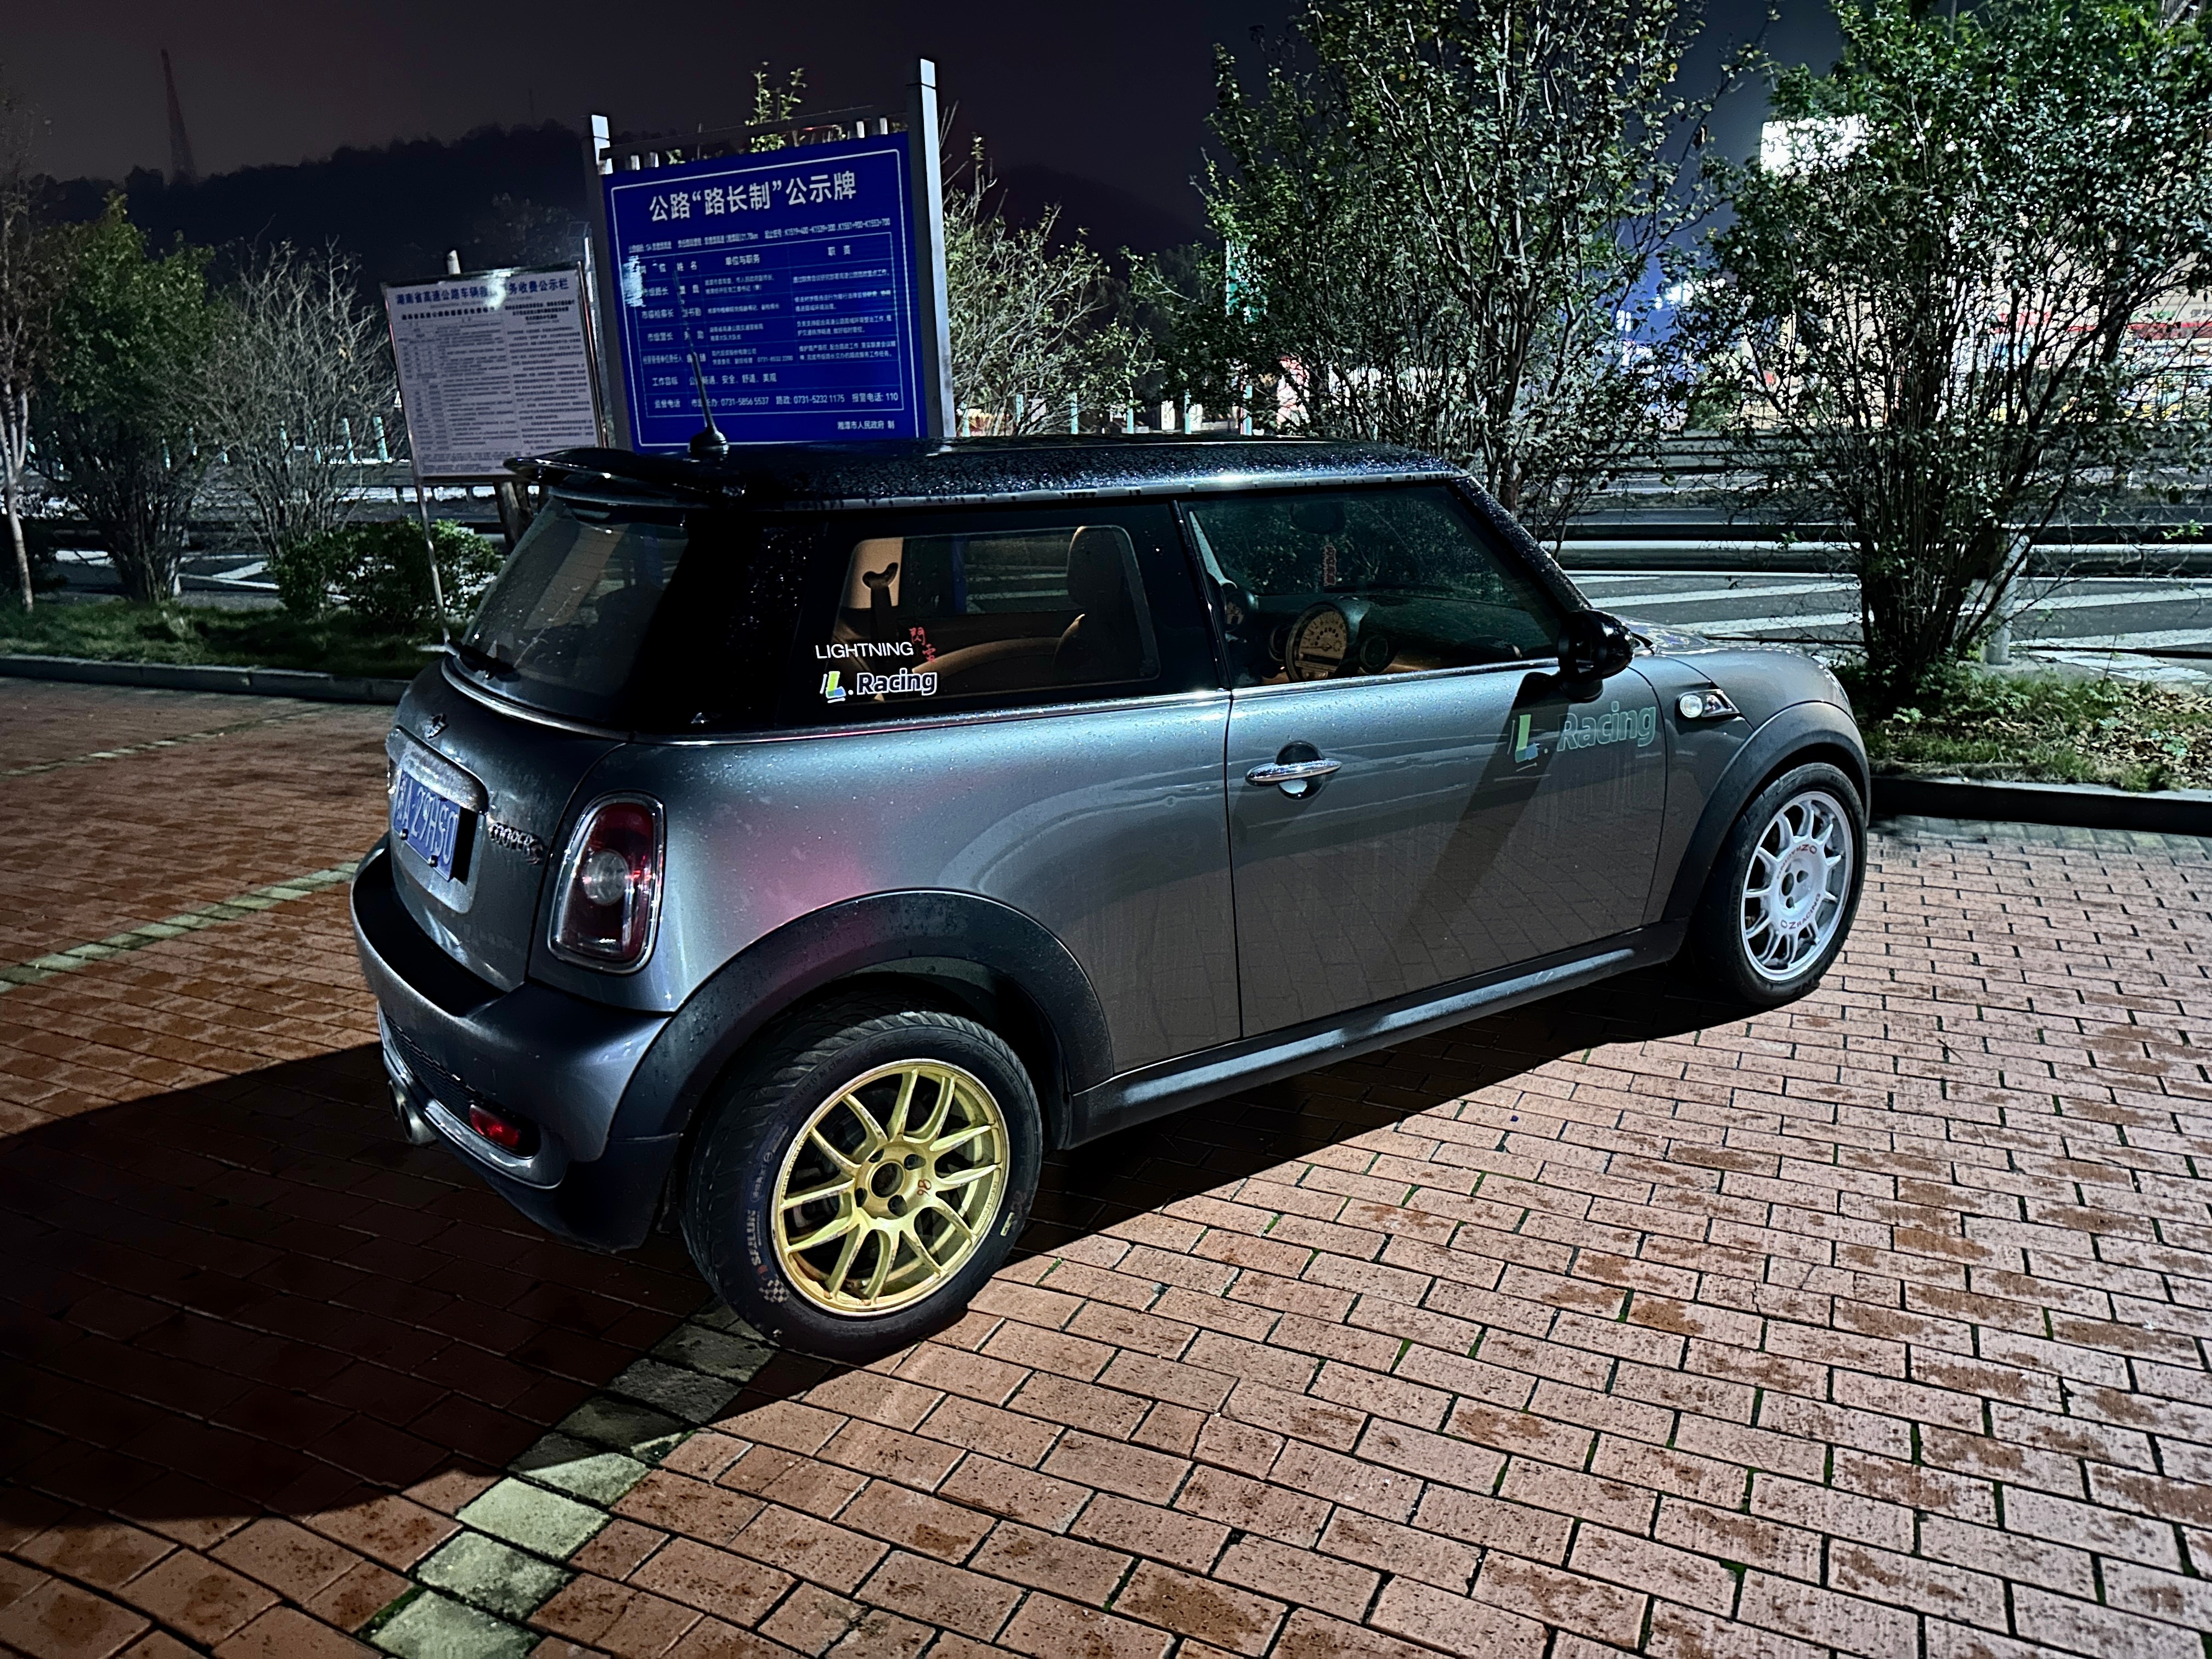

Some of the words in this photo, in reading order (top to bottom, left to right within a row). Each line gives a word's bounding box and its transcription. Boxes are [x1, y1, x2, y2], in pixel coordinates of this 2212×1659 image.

[397, 278, 569, 305] 湖南省高速公路车辆救务收费公示栏
[652, 377, 678, 386] 工作目标
[885, 392, 898, 401] 110
[815, 641, 914, 659] LIGHTNING
[857, 668, 937, 696] Racing
[1557, 701, 1657, 752] Racing
